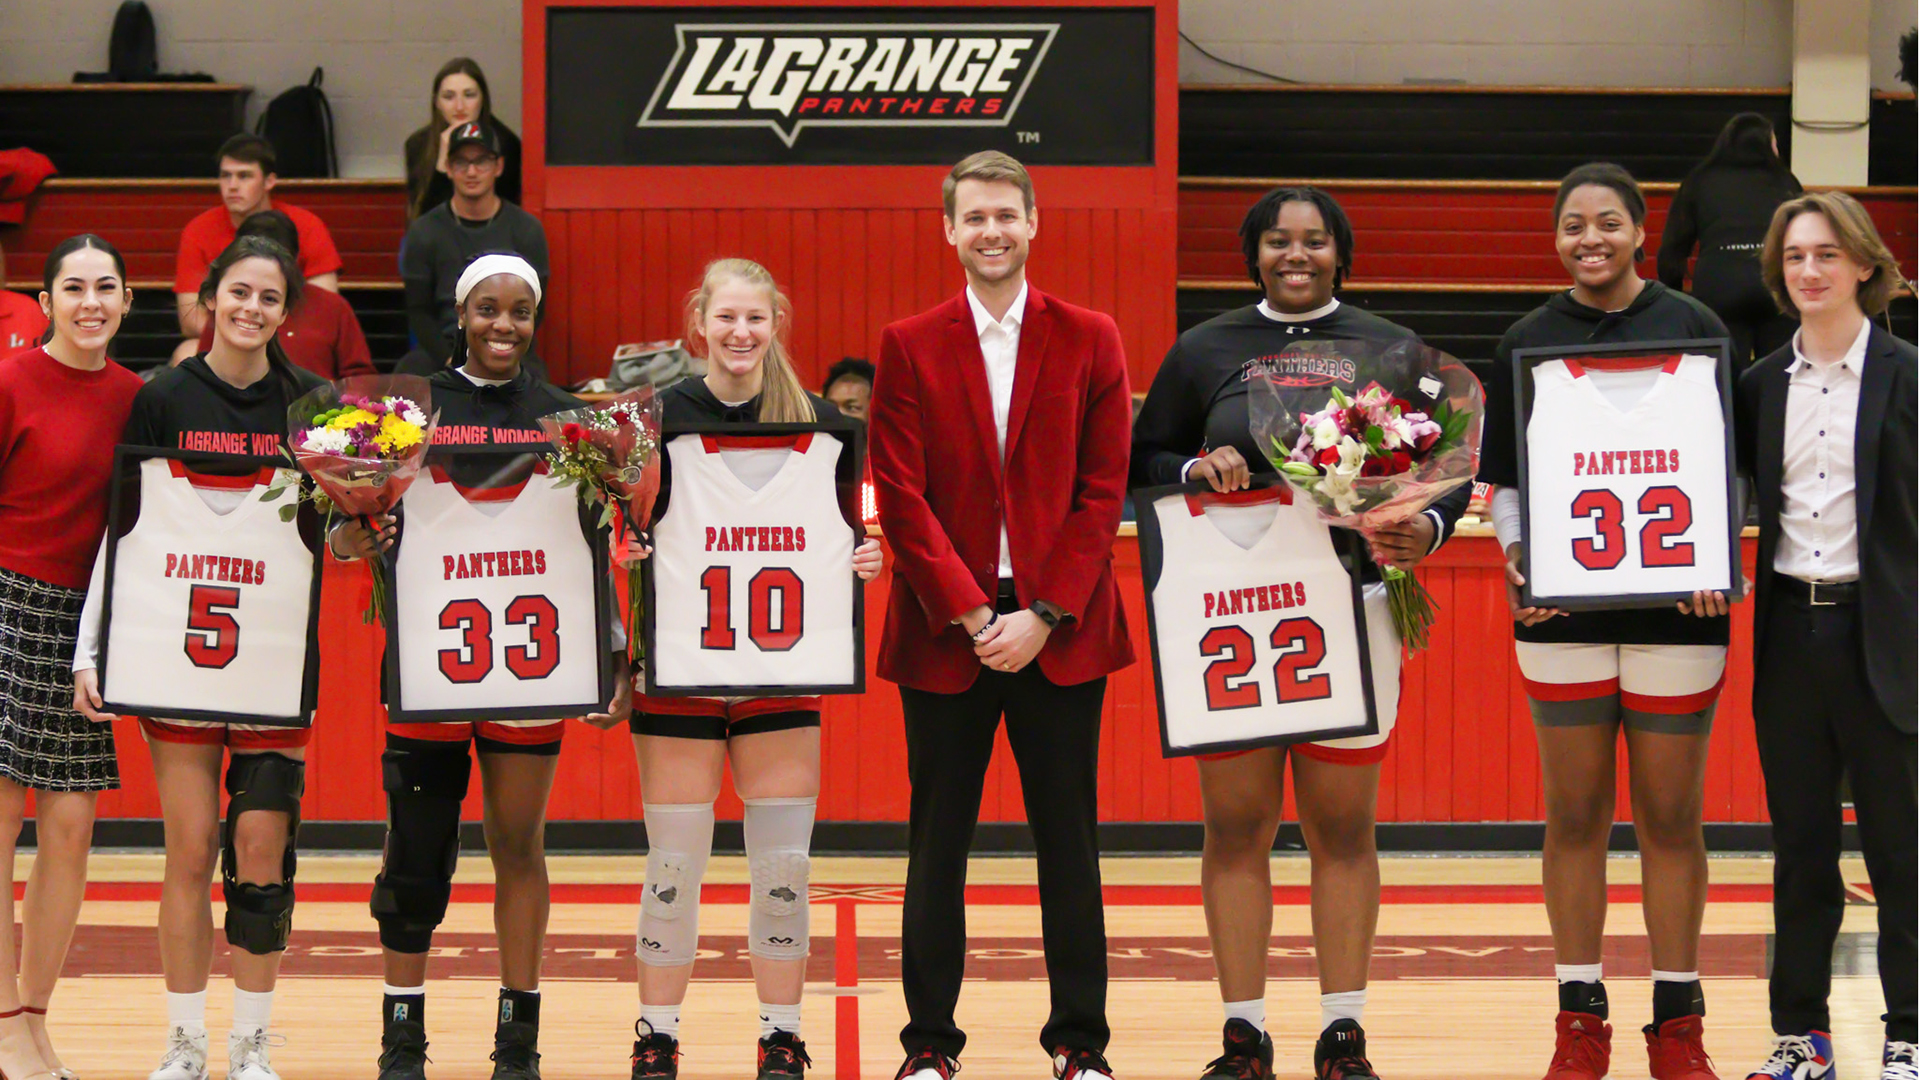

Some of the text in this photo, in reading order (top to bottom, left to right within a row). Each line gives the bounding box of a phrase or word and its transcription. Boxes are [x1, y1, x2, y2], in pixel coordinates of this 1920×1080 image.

[798, 97, 1002, 115] PANTHERS
[1016, 131, 1040, 143] TM
[1241, 358, 1356, 383] PANTHERS
[1575, 449, 1679, 476] PANTHERS
[705, 526, 806, 552] PANTHERS
[1571, 485, 1695, 571] 32
[165, 553, 266, 586] PANTHERS
[443, 549, 547, 580] PANTHERS
[700, 565, 804, 652] 10
[1203, 581, 1307, 619] PANTHERS
[184, 584, 240, 669] 5
[438, 594, 560, 684] 33
[1199, 616, 1332, 712] 22
